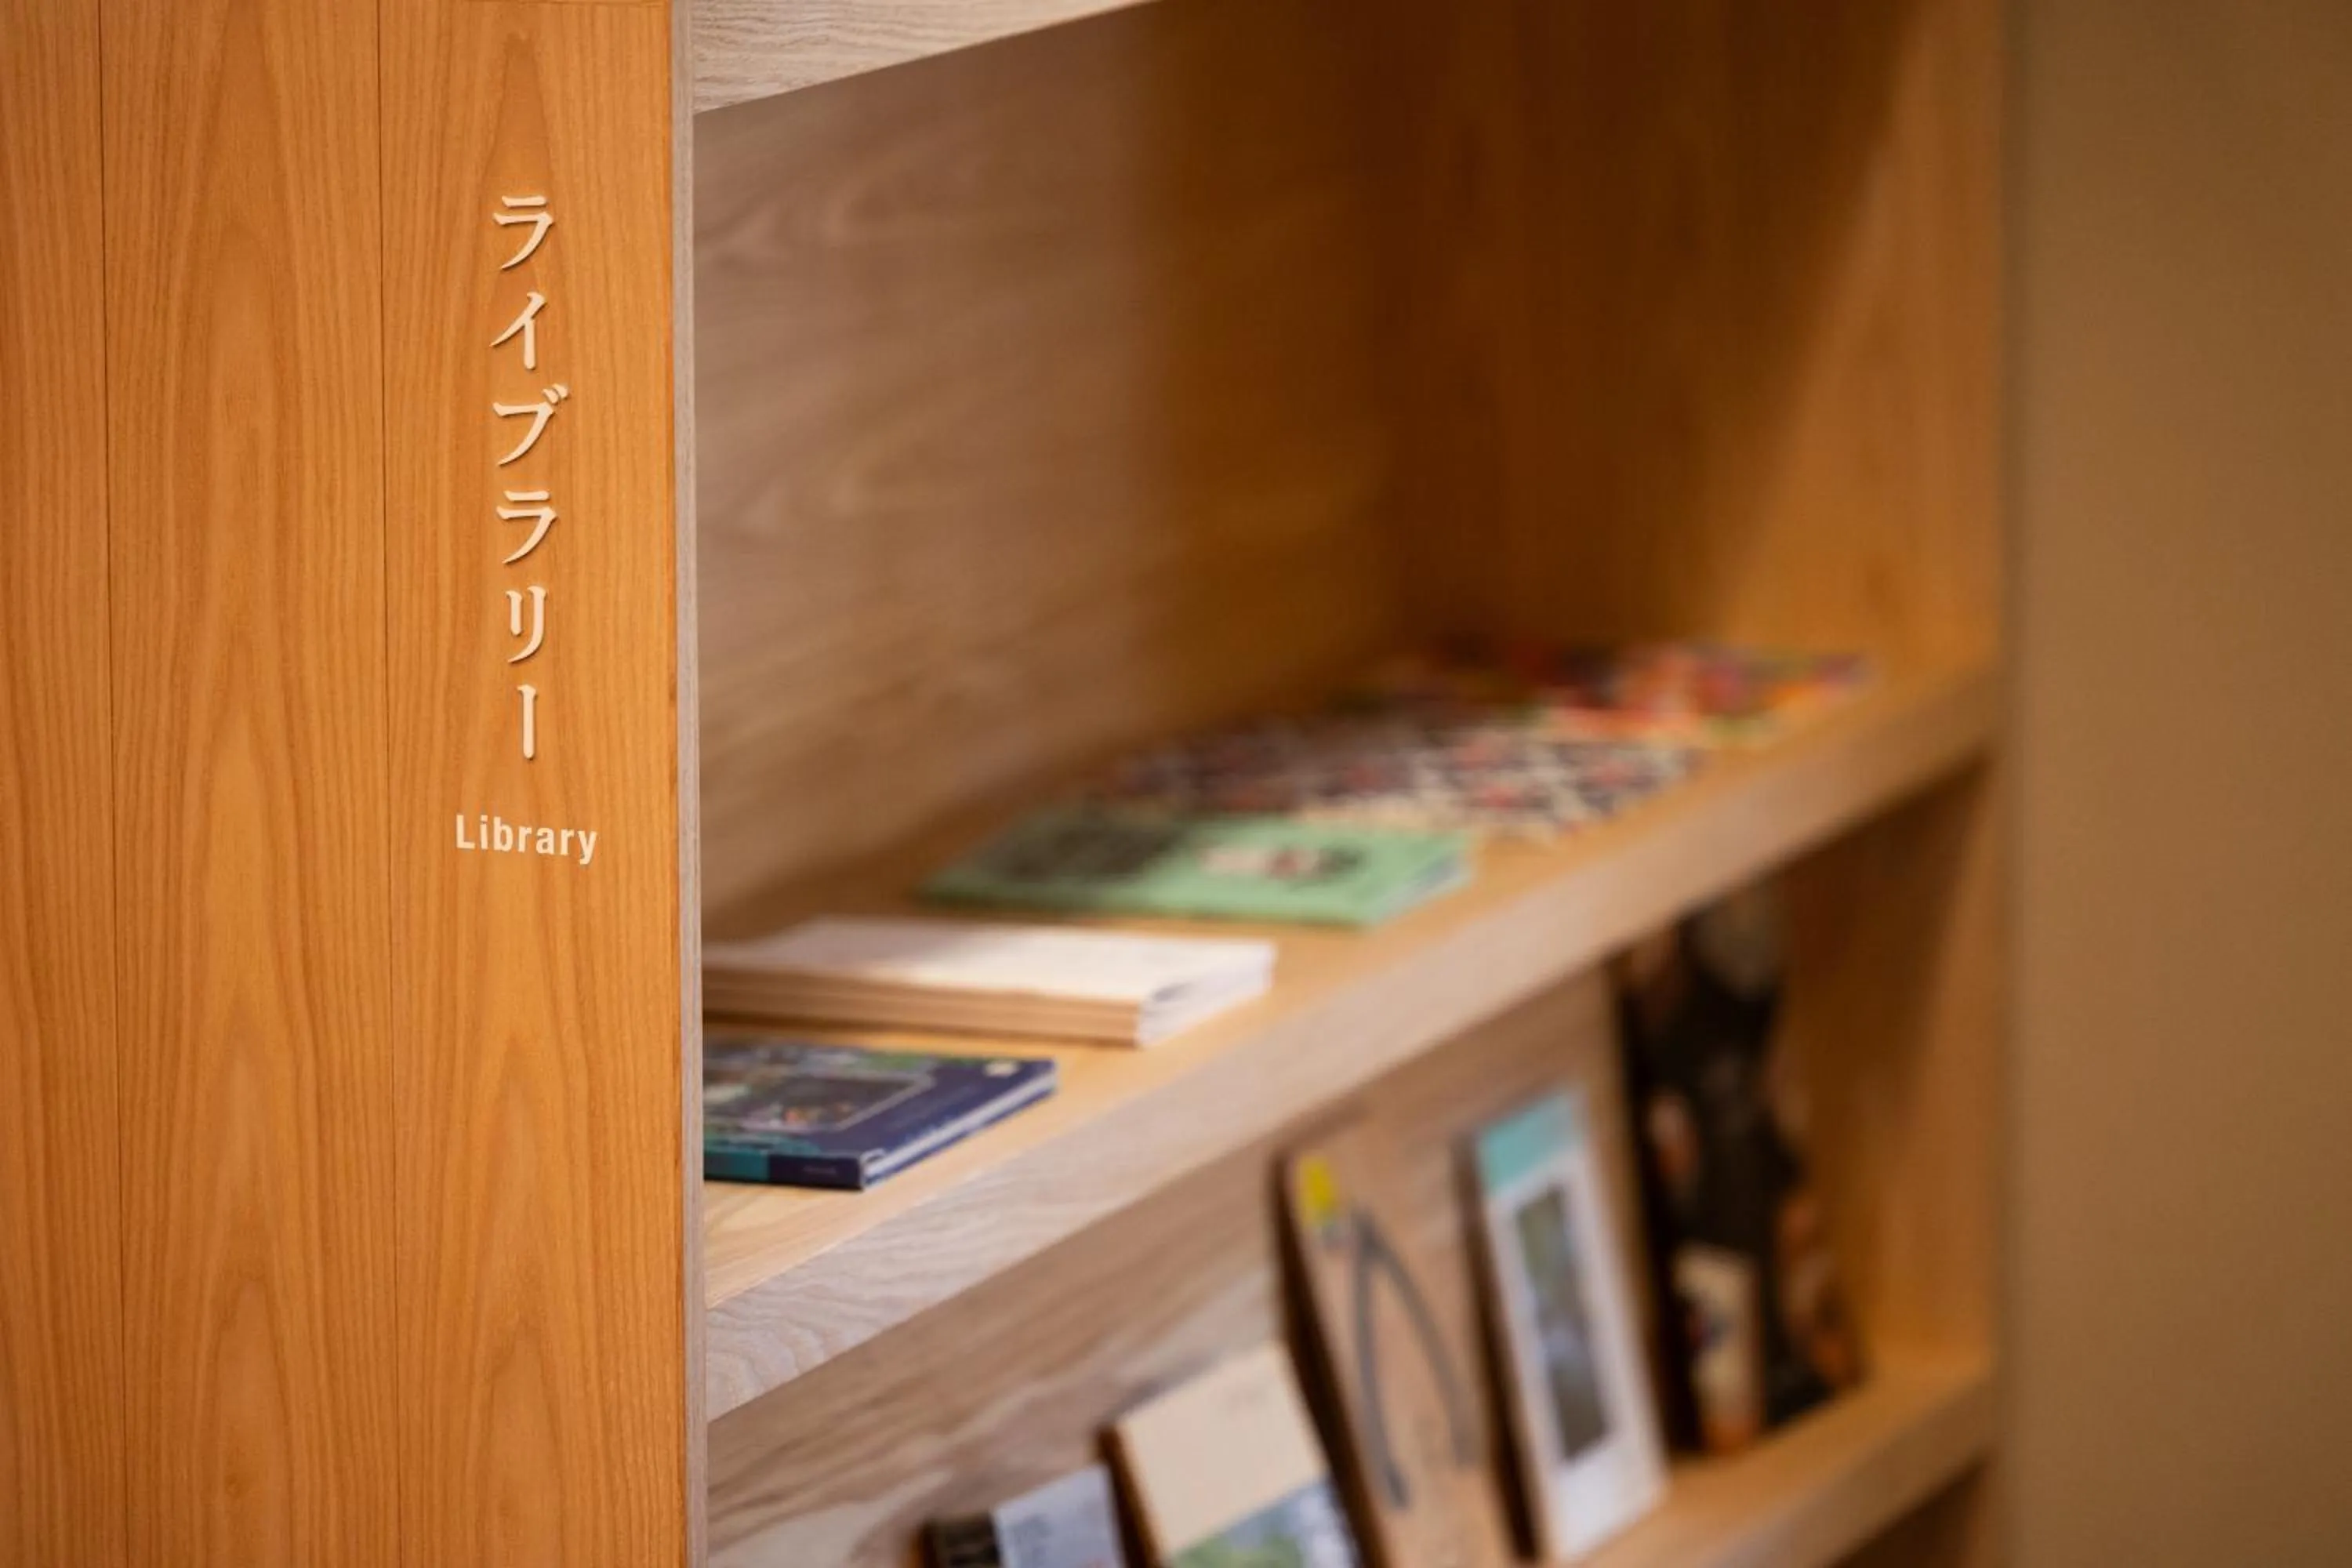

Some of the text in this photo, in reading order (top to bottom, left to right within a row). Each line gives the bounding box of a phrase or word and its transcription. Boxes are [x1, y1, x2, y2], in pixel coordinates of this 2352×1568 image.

[491, 194, 568, 760] ライブラリー
[456, 814, 597, 866] Library
